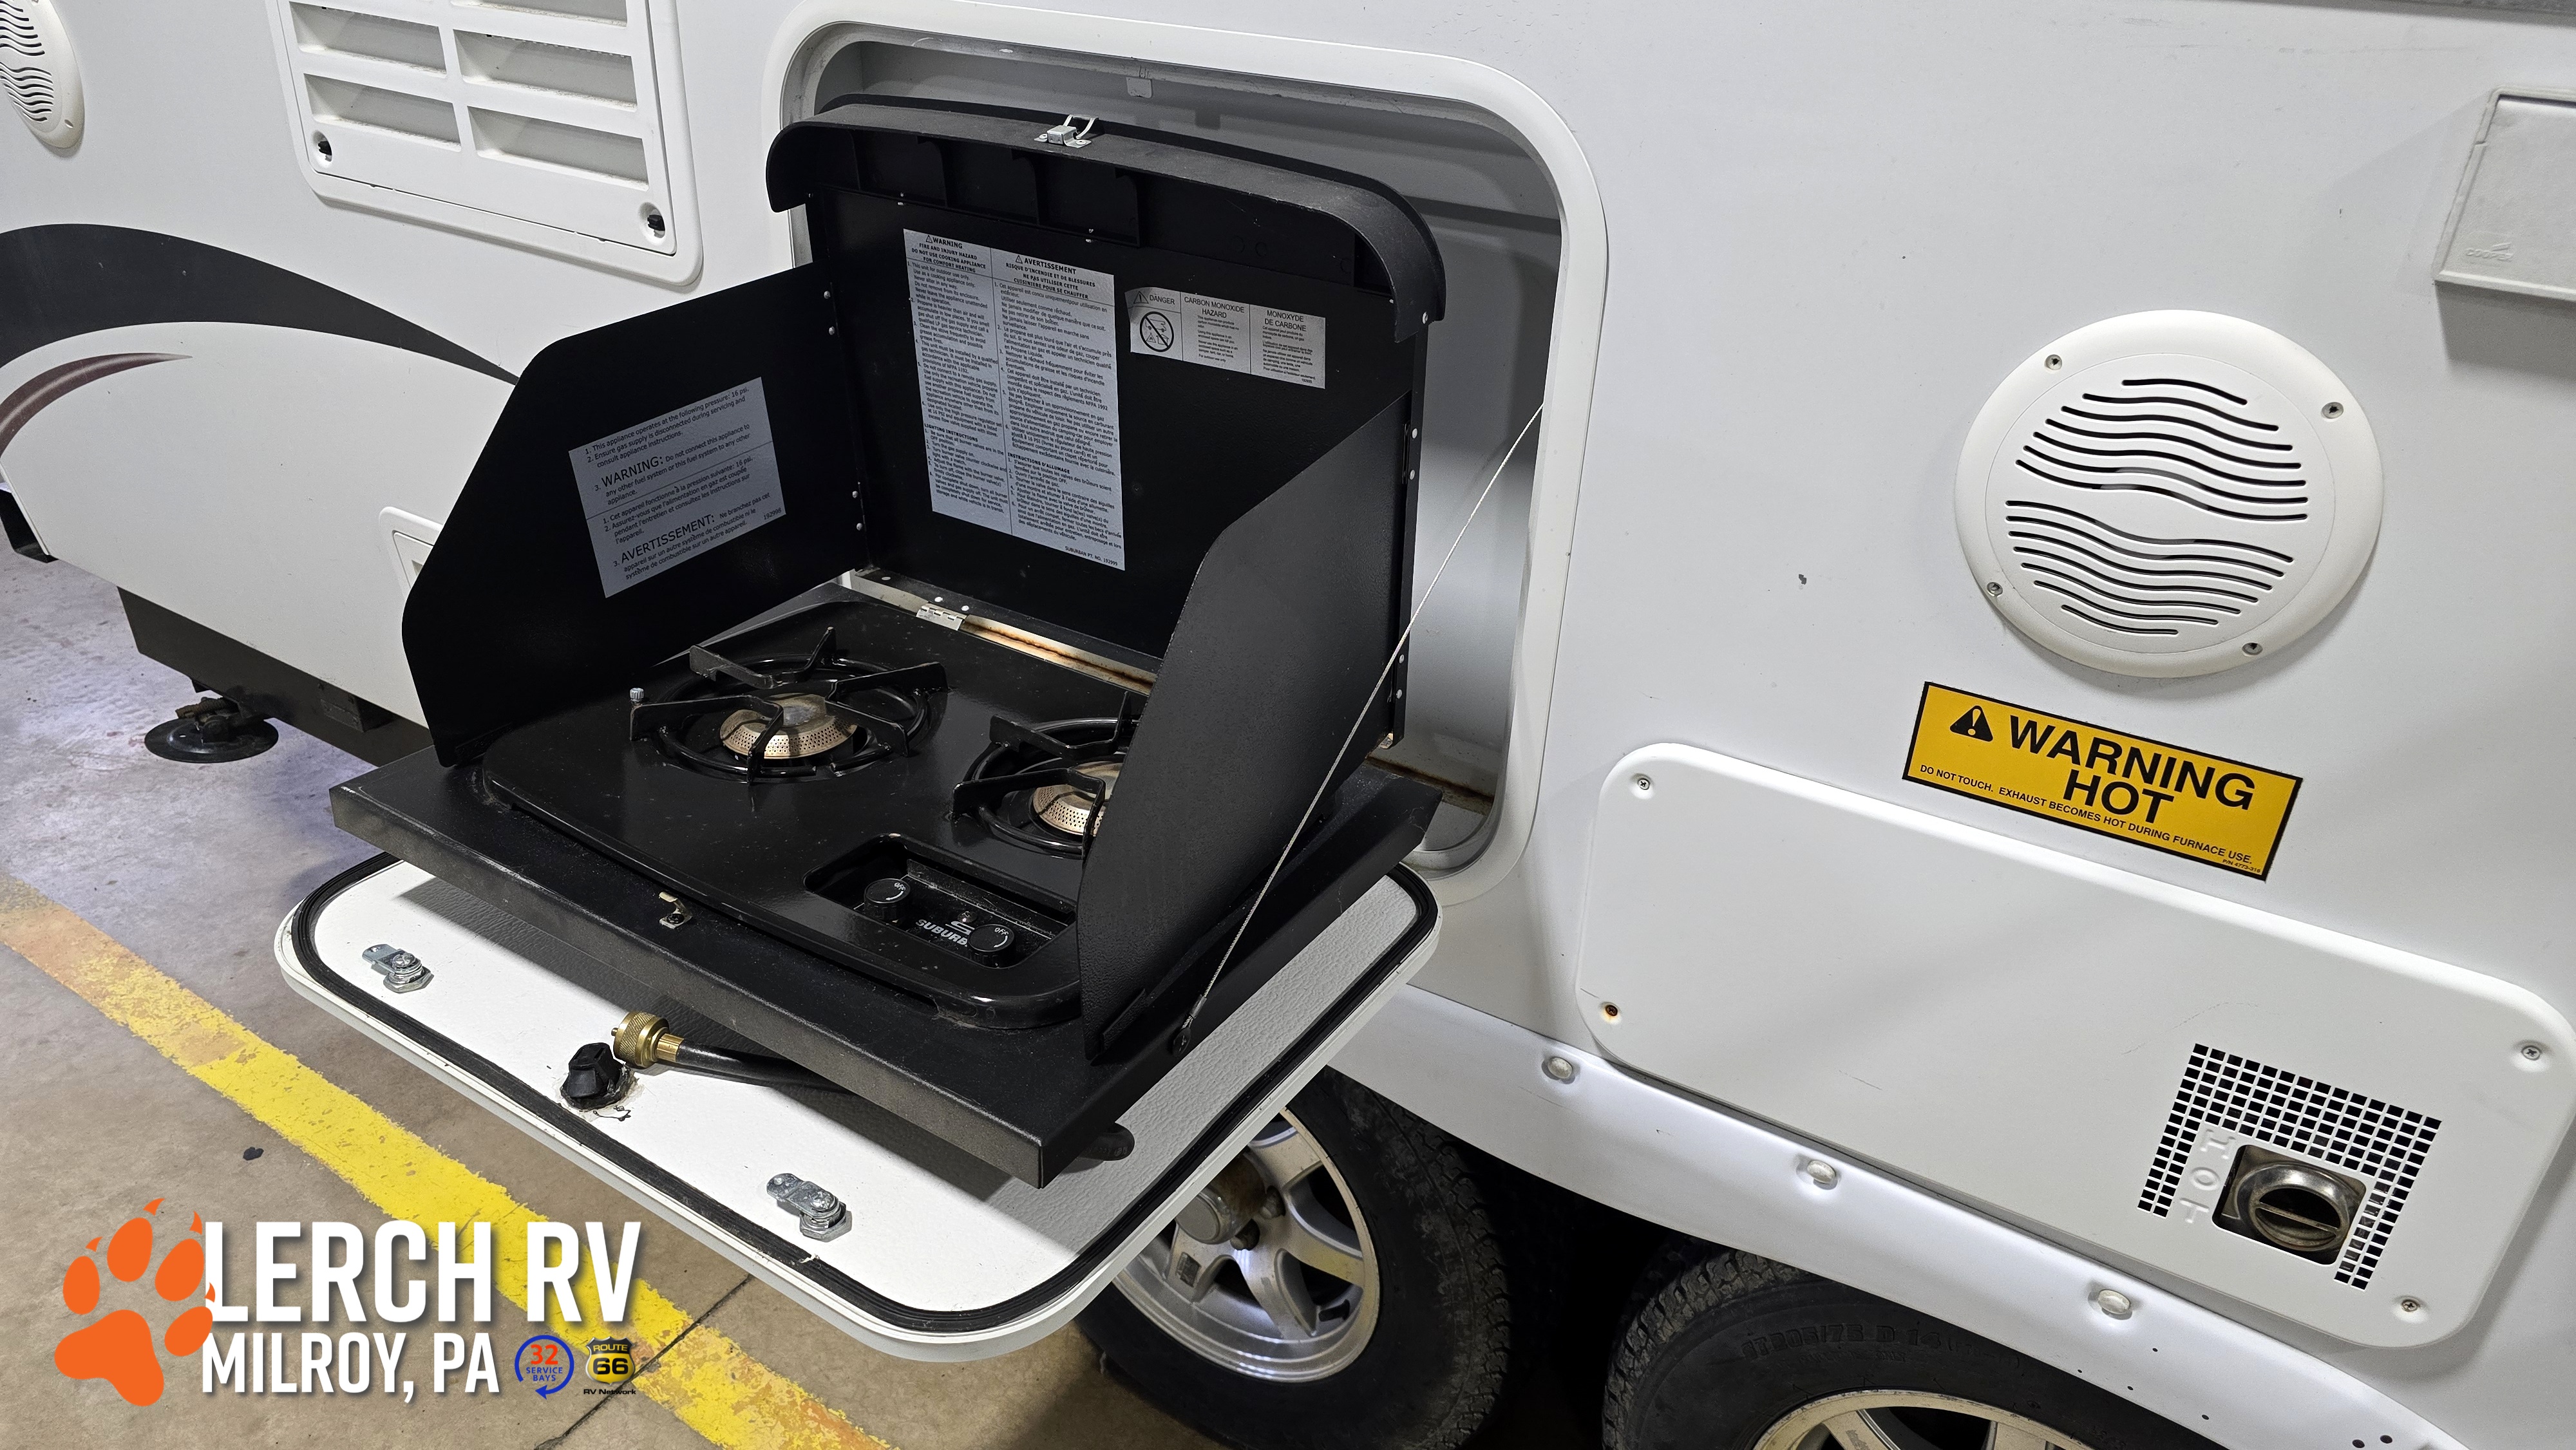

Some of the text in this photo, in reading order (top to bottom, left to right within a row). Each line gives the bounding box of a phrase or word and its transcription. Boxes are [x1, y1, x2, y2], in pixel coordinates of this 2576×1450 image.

[932, 236, 964, 249] WARNING
[938, 254, 960, 263] COOKING
[960, 259, 986, 269] APPLIANCE
[940, 247, 958, 256] INJURY
[958, 251, 977, 260] HAZARD
[933, 259, 954, 268] COMFORT
[955, 264, 976, 273] HEATING
[1005, 262, 1023, 270] RISQUE
[1024, 267, 1052, 278] D'INCENDIE
[1068, 276, 1095, 287] BLESSURES
[1024, 258, 1076, 274] AVERTISSEMENT
[1040, 277, 1063, 287] UTILISER
[1063, 289, 1088, 299] CHAUFFER
[1149, 294, 1175, 305] DANGER
[1184, 296, 1244, 313] CARBON MONOXIDE
[1202, 308, 1227, 318] HAZARD
[1264, 317, 1274, 326] DE
[1274, 320, 1306, 332] CARBONE
[1267, 309, 1303, 322] MONOXYDE
[591, 442, 605, 451] This
[606, 431, 634, 446] appliance
[635, 420, 661, 435] operates
[679, 404, 704, 418] following
[705, 394, 730, 409] pressure:
[739, 386, 749, 395] psi.
[594, 447, 616, 460] Ensure
[616, 443, 627, 453] gas
[628, 435, 647, 447] supply
[654, 417, 691, 436] disconnected
[692, 411, 710, 421] during
[710, 400, 734, 414] servicing
[735, 395, 745, 404] and
[923, 422, 978, 442] LIGHTING INSTRUCTIONS
[601, 456, 663, 487] WARNING:
[674, 450, 685, 458] not
[685, 440, 706, 454] connect
[706, 437, 717, 445] this
[718, 426, 743, 440] appliance
[1007, 452, 1070, 474] INSTRUCTIONS D'ALLUMAGE
[609, 513, 621, 521] Cet
[621, 501, 645, 516] appareil
[645, 489, 675, 506] fonctionne
[687, 475, 710, 489] pression
[710, 464, 734, 478] suivante:
[735, 459, 743, 467] 16
[743, 455, 753, 465] psi.
[612, 508, 650, 529] Assurez-vous
[650, 504, 662, 513] que
[662, 487, 700, 507] l'alimentation
[708, 479, 719, 488] gaz
[728, 464, 747, 478] coupée
[614, 522, 638, 538] pendant
[638, 510, 667, 526] l'entretien
[675, 495, 701, 510] consultez
[710, 478, 741, 494] instructions
[763, 507, 781, 520] 192998
[621, 514, 715, 563] AVERTISSEMENT:
[727, 501, 752, 515] branchez
[752, 496, 761, 505] pas
[625, 564, 649, 579] système
[658, 545, 691, 564] combustible
[710, 531, 724, 541] autre
[724, 520, 747, 534] appareil.
[1065, 545, 1086, 556] SUBURBAN
[2010, 715, 2255, 810] WARNING
[2063, 769, 2174, 824] HOT
[1920, 764, 2251, 864] DO NOT TOUCH. EXHAUST BECOMES HOT DURING FURNACE USE.
[915, 919, 969, 948] SUBURB
